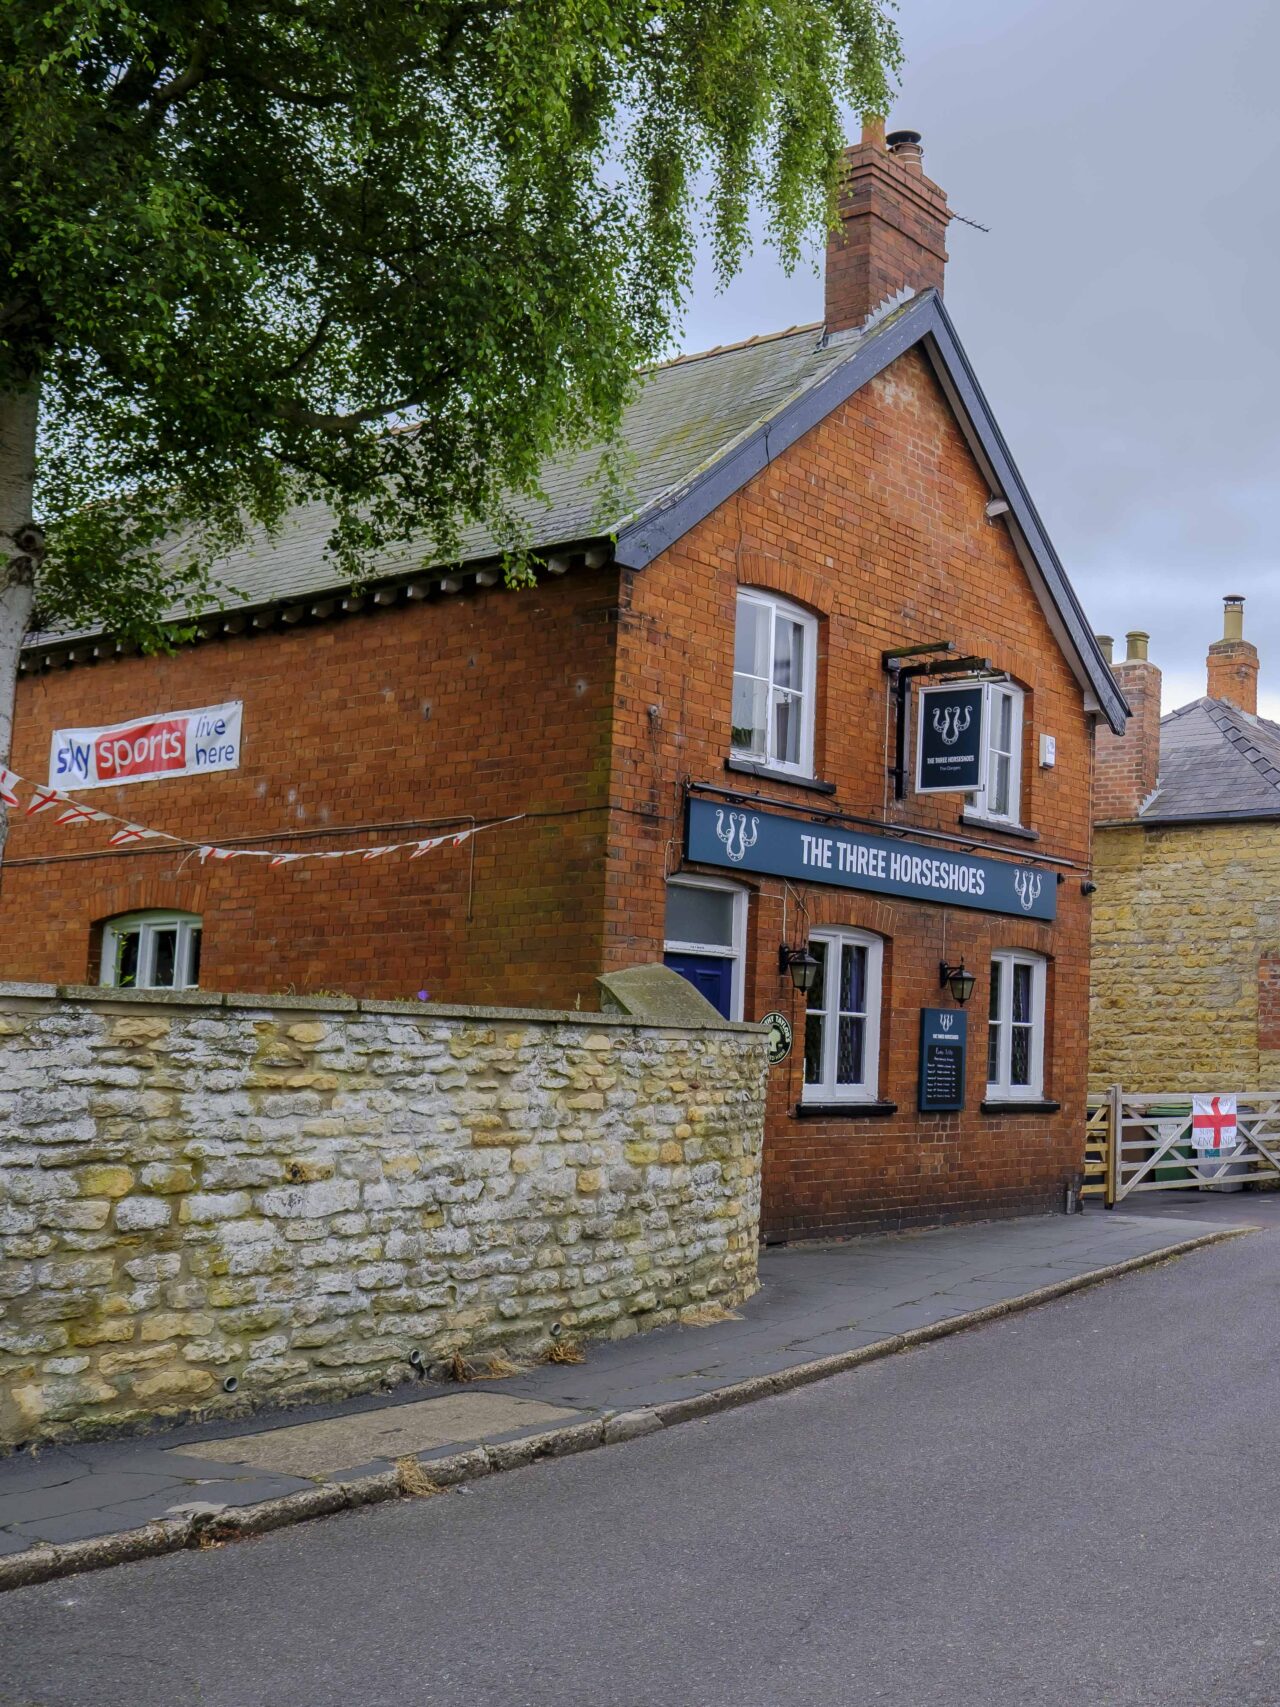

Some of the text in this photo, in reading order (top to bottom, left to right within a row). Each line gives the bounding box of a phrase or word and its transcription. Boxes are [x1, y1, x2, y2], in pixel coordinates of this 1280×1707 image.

[195, 716, 226, 738] live
[57, 729, 182, 780] sky sports
[195, 743, 235, 766] here
[935, 756, 947, 764] THREE
[801, 834, 985, 896] THE THREE HORSESHOES
